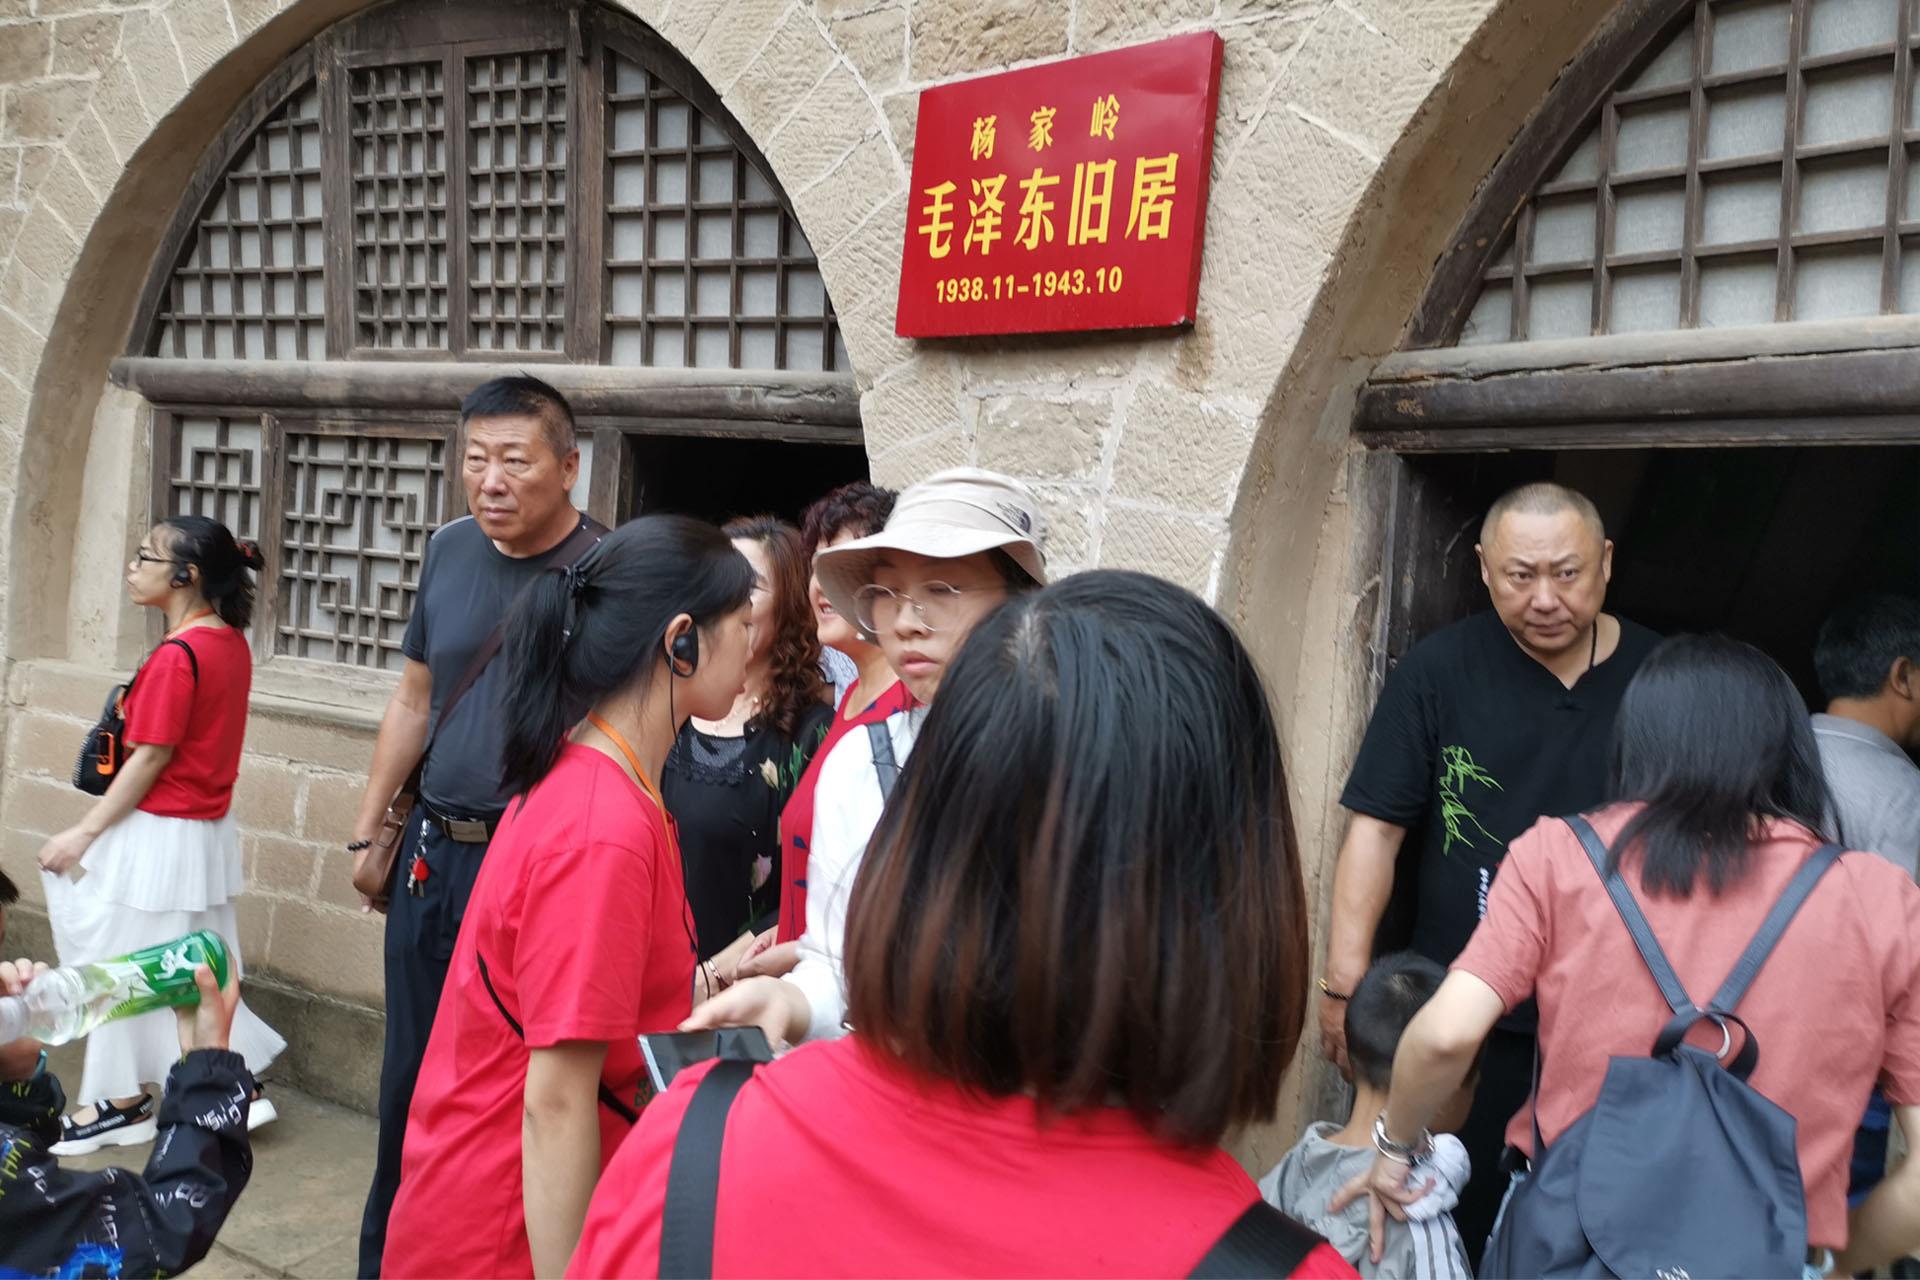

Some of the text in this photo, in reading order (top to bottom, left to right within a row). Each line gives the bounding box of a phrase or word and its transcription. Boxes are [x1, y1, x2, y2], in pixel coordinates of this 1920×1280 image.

[970, 94, 1120, 160] 杨家岭
[918, 152, 1179, 259] 毛泽东旧居
[936, 265, 1123, 304] 1938.11-1943.10
